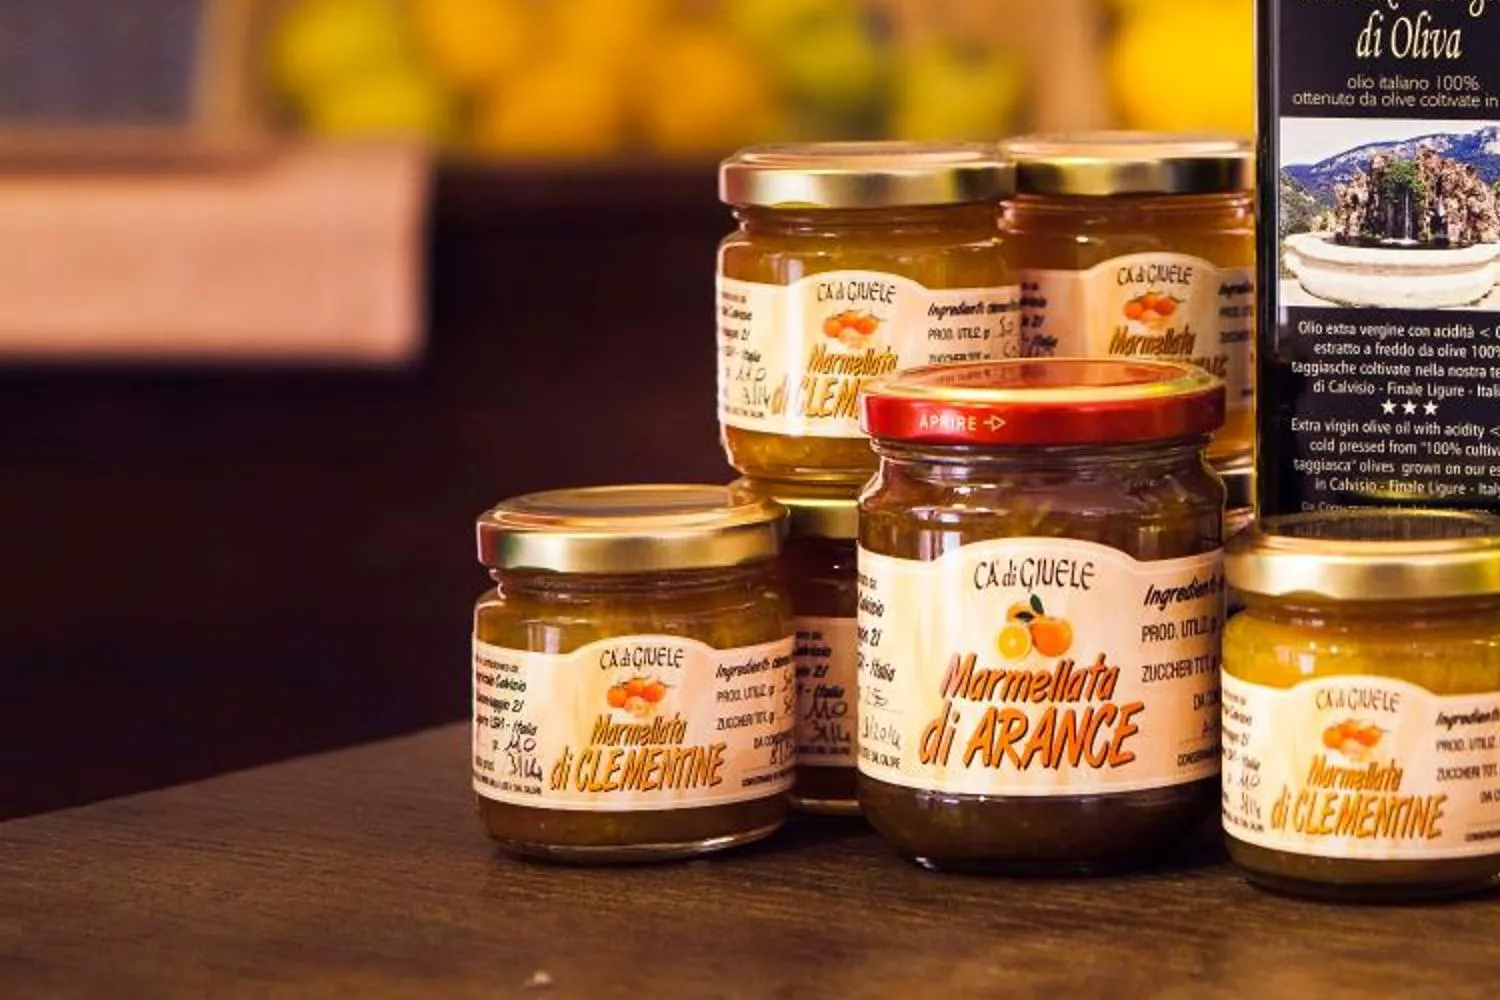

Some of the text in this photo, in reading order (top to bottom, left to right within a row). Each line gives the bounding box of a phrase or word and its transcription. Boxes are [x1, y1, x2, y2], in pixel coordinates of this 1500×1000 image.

[1355, 9, 1463, 61] di Oliva
[1347, 74, 1481, 91] olio italiano 100%
[1292, 91, 1355, 106] ottenuto
[1359, 92, 1378, 107] da
[1381, 92, 1416, 108] olive
[1420, 92, 1481, 109] coltivate
[1485, 93, 1499, 109] in
[1145, 263, 1194, 288] GIUELE
[846, 280, 898, 305] GIUELE
[1107, 323, 1198, 356] Marmellata
[1298, 320, 1323, 336] Olio
[1325, 321, 1357, 337] extra
[1359, 322, 1405, 341] vergine
[1407, 326, 1431, 338] con
[1433, 322, 1475, 339] acidità
[806, 342, 899, 376] Marmellata
[1313, 342, 1361, 356] estratto
[1363, 345, 1372, 356] a
[1375, 342, 1414, 357] freddo
[1417, 343, 1435, 357] da
[1437, 344, 1468, 358] olive
[1291, 360, 1357, 378] taggiasche
[1359, 362, 1411, 377] coltivate
[1415, 363, 1445, 378] nella
[1448, 365, 1487, 379] nostra
[1313, 380, 1325, 394] di
[1328, 380, 1375, 396] Calvisio
[1387, 380, 1423, 397] Finale
[1427, 382, 1466, 400] Ligure
[919, 413, 977, 432] APRIRE
[1291, 417, 1322, 433] Extra
[1324, 418, 1359, 435] virgin
[1362, 420, 1391, 435] olive
[1395, 421, 1411, 436] oil
[1414, 422, 1441, 437] with
[1443, 423, 1485, 441] acidity
[1309, 438, 1336, 453] cold
[1338, 439, 1386, 457] pressed
[1388, 439, 1417, 455] from
[1359, 459, 1395, 474] olives
[1401, 464, 1441, 478] grown
[1445, 465, 1462, 477] on
[1464, 465, 1486, 477] our
[1314, 477, 1327, 491] in
[1329, 476, 1377, 493] Calvisio
[1388, 478, 1425, 495] Finale
[1428, 479, 1467, 499] Ligure
[1001, 560, 1018, 588] di
[1019, 557, 1096, 594] GIUELE
[1140, 621, 1179, 643] PROD.
[631, 646, 685, 670] GIUELE
[938, 652, 1121, 704] Marmellata
[1348, 687, 1401, 714] GIUELE
[589, 711, 689, 748] Marmellata
[918, 700, 960, 768] di
[963, 701, 1145, 771] ARANCE
[549, 744, 575, 791] di
[575, 742, 728, 794] CLEMENTINE
[1306, 753, 1405, 793] Marmellata
[1270, 783, 1291, 830] di
[1291, 787, 1448, 840] CLEMENTINE
